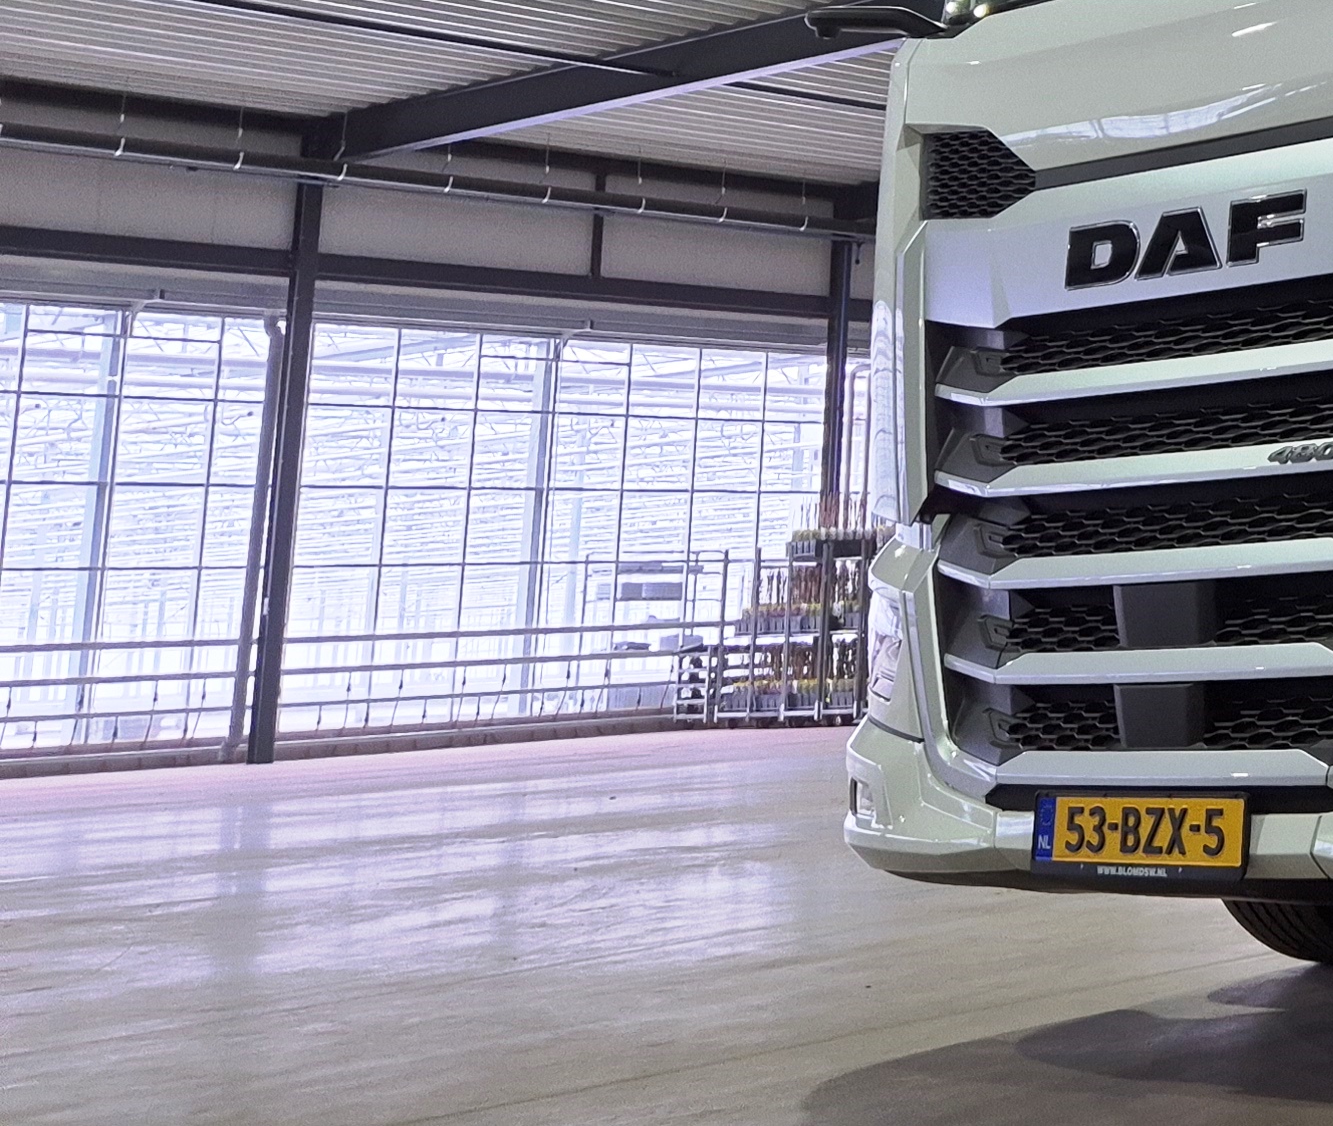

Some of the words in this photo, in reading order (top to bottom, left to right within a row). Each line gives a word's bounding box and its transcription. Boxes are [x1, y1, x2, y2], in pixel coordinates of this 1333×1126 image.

[1064, 188, 1308, 291] DAF
[1037, 834, 1051, 850] NL
[1065, 804, 1225, 857] 53-BZX-5
